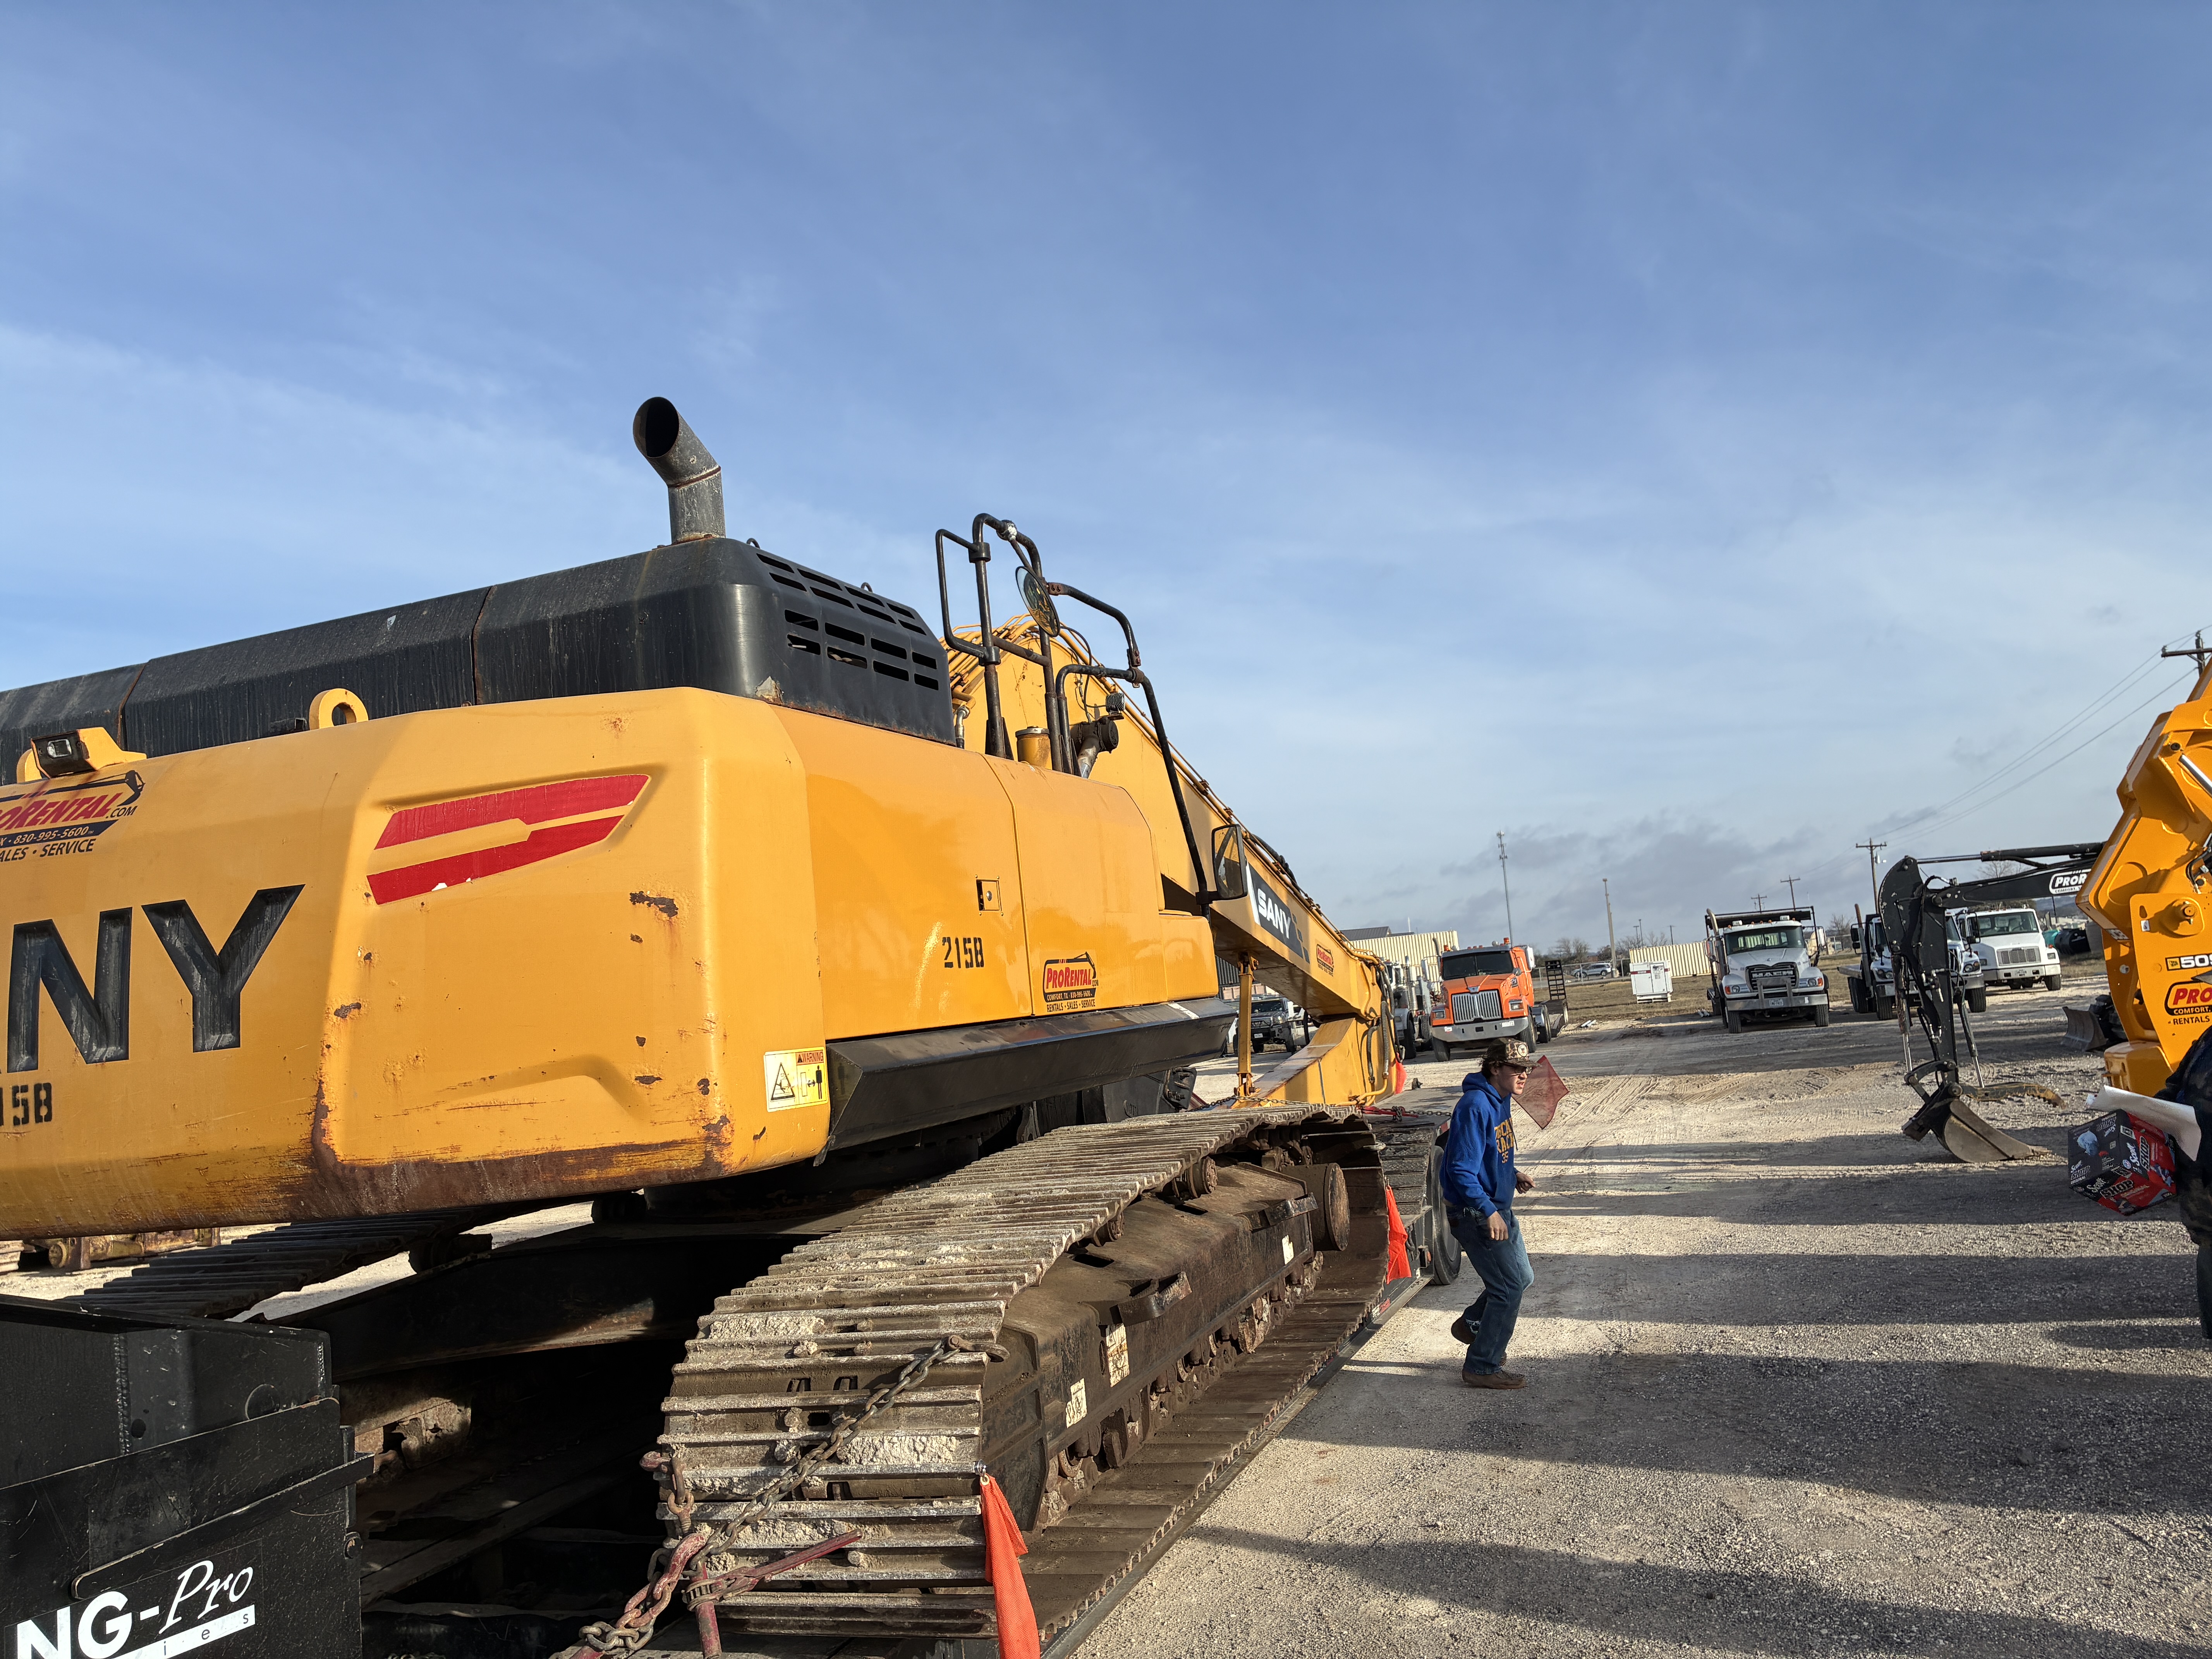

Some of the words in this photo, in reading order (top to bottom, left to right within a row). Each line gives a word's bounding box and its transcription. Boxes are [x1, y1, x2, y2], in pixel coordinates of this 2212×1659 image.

[14, 826, 89, 844] 830-995-5600
[40, 838, 96, 857] SERVICE
[1258, 888, 1291, 939] SANY
[2180, 954, 2212, 968] 50
[7, 884, 306, 1073] NY
[2173, 988, 2212, 1005] PRO
[1047, 1003, 1063, 1012] RENTALS
[1067, 1001, 1078, 1010] SALES
[1081, 999, 1095, 1008] SERVICE
[2173, 1015, 2210, 1025] RENTALS
[802, 1052, 823, 1063] WARNING
